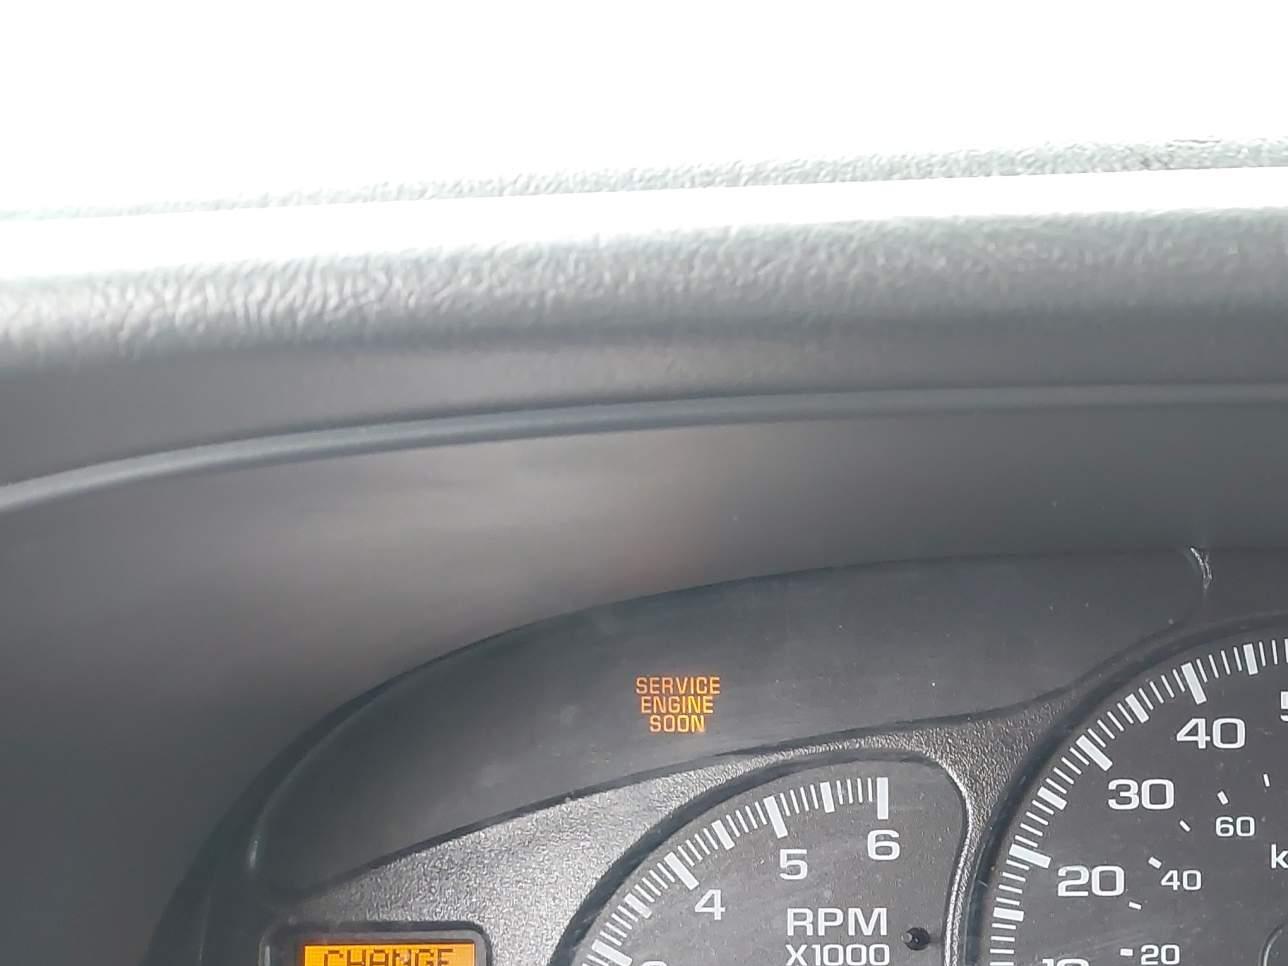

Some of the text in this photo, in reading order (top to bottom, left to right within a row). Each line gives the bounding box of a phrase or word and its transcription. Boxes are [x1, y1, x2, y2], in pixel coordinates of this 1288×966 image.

[635, 676, 721, 695] SERVICE
[640, 696, 714, 714] ENGINE
[649, 715, 705, 733] SOON
[1176, 718, 1246, 750] 40
[1107, 779, 1175, 811] 30
[1215, 816, 1256, 838] 60
[868, 829, 900, 861] 6
[779, 848, 809, 881] 5
[1057, 866, 1125, 897] 20
[1161, 870, 1202, 892] 40
[694, 888, 726, 921] 4
[786, 907, 889, 937] RPM
[1140, 943, 1181, 966] 20
